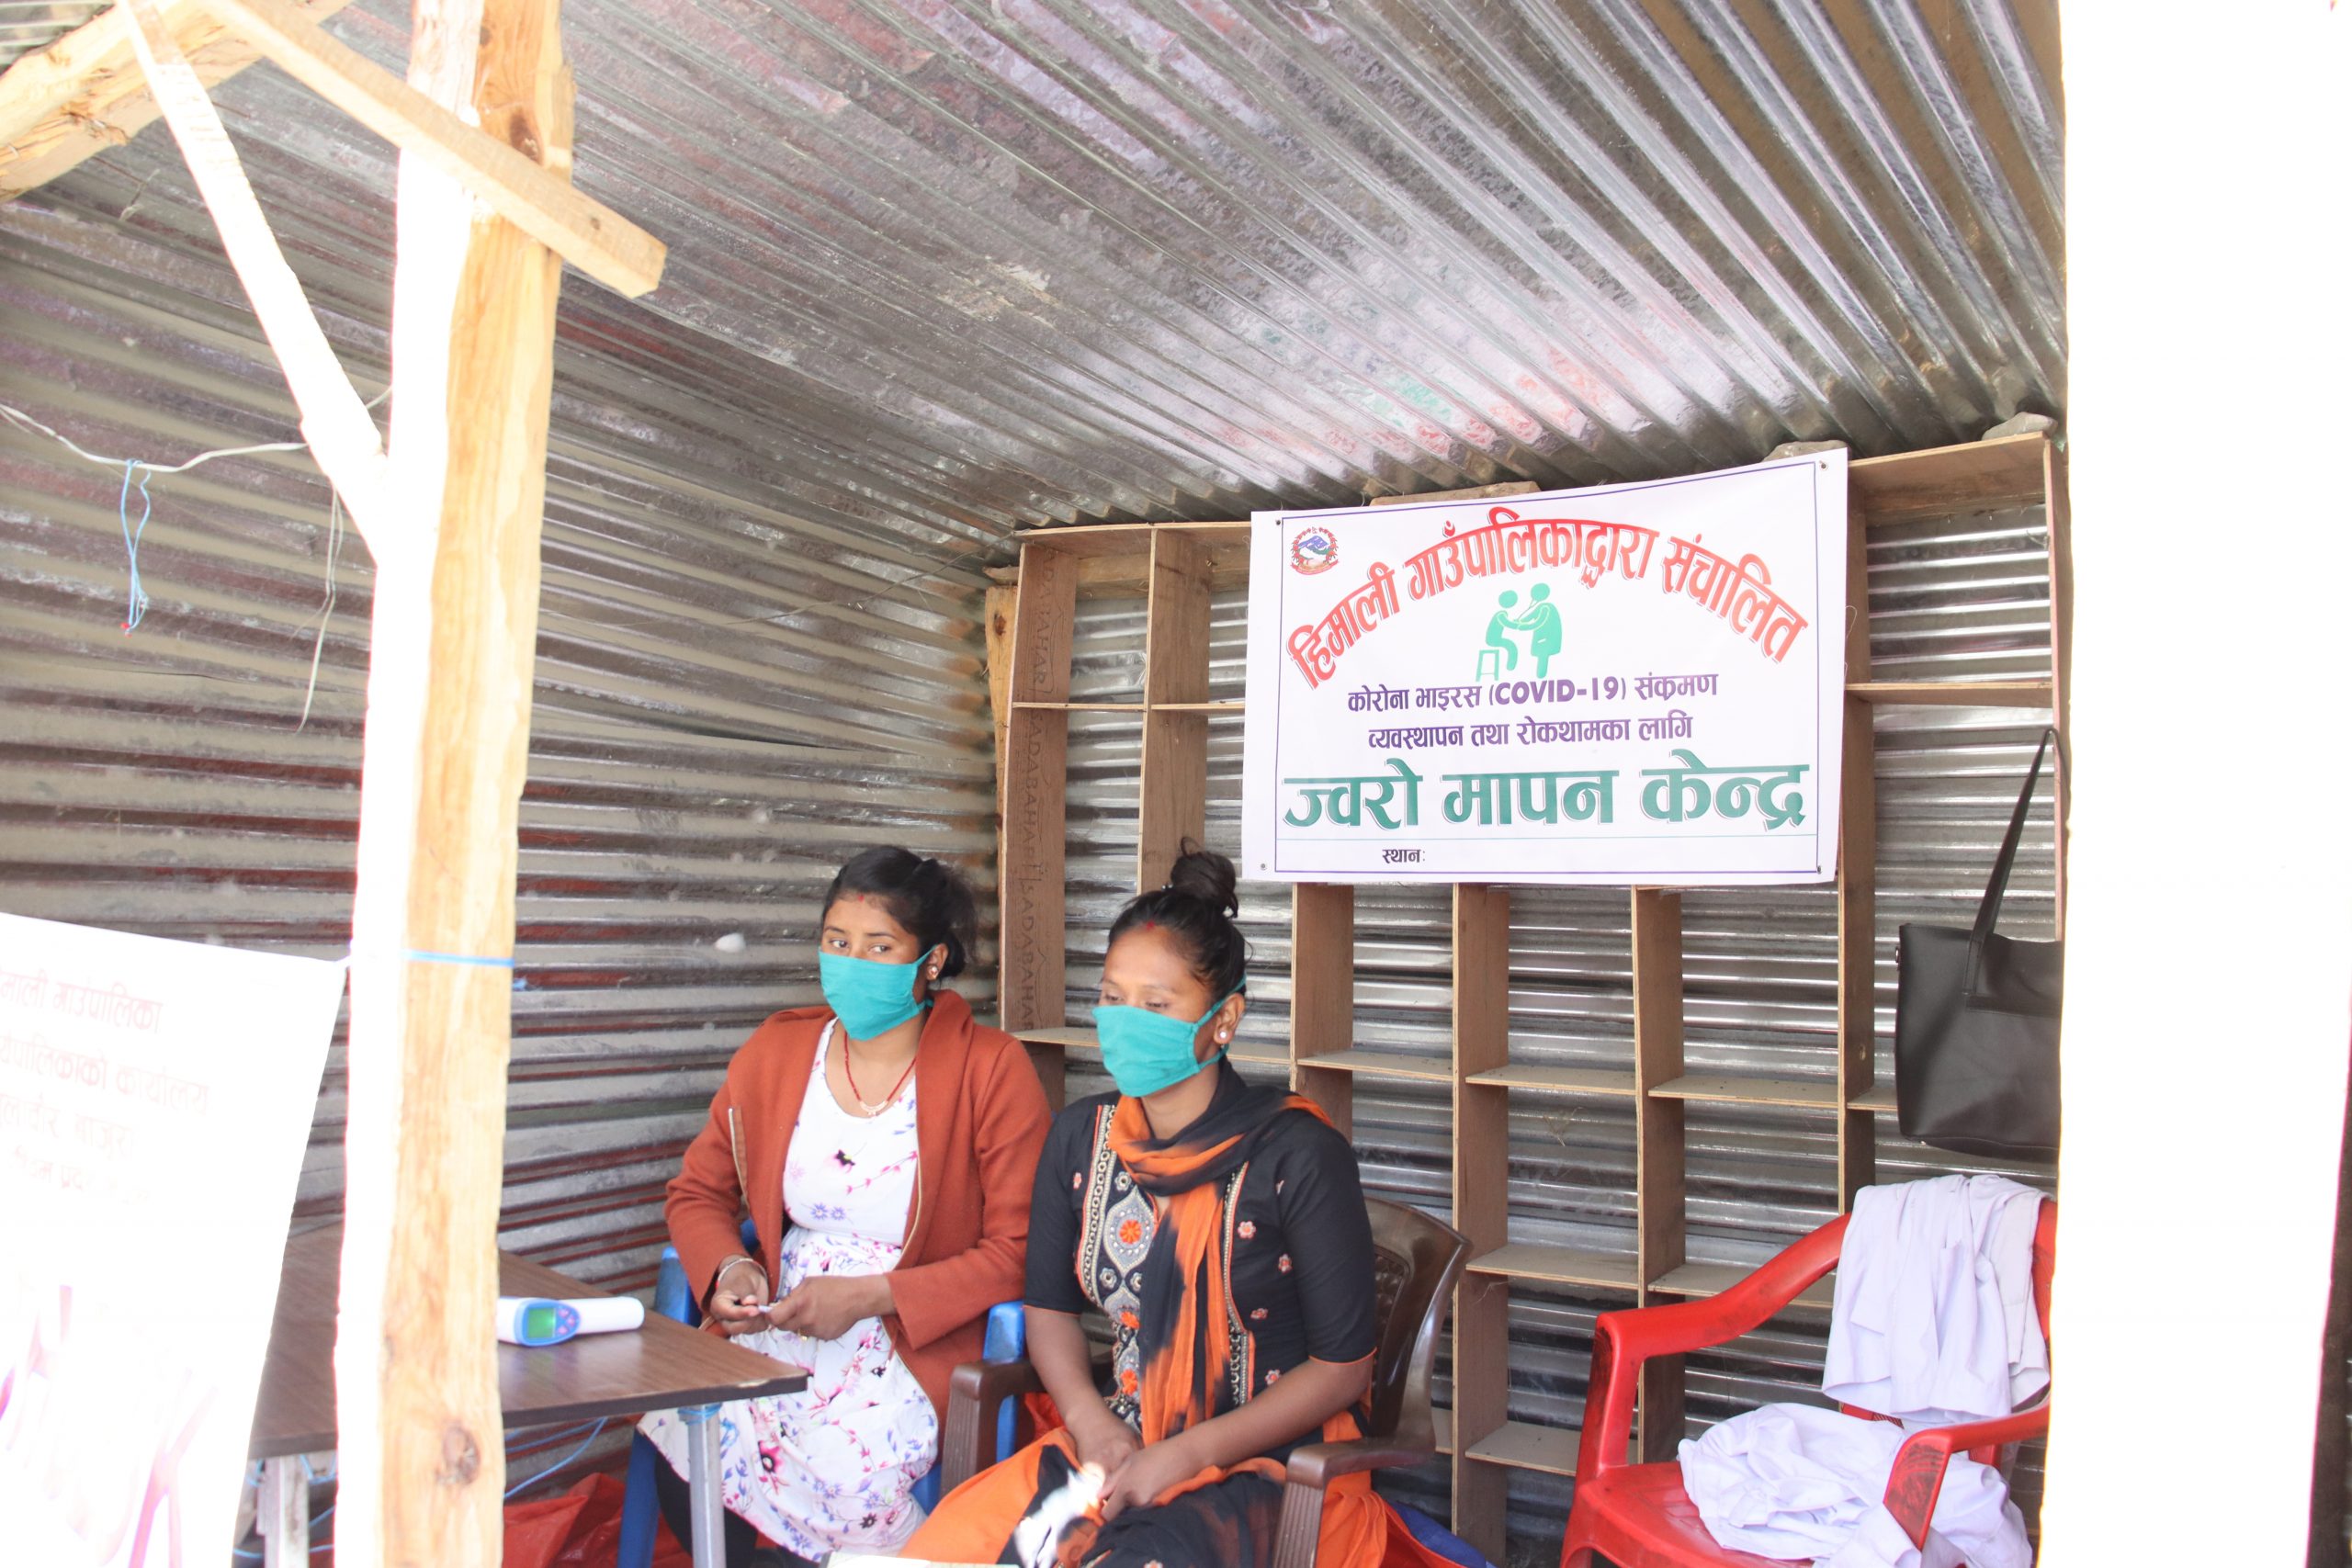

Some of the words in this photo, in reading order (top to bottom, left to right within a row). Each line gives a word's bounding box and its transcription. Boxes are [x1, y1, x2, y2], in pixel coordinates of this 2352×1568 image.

[1287, 561, 1401, 690] हिमाली
[1663, 533, 1808, 664] संचालित
[1348, 683, 1410, 712] कोरोना
[1415, 685, 1483, 711] भाइरस
[1488, 676, 1626, 705] (COVID-19)
[1634, 671, 1719, 701] संक्रमण
[1368, 726, 1464, 750] व्यवस्थापन
[1470, 724, 1510, 747] तथा
[1516, 716, 1631, 745] रोकथामका
[1638, 709, 1693, 741] लागि
[1283, 758, 1424, 830] ज्वरो
[1440, 771, 1620, 826] मापन
[1639, 749, 1810, 830] केन्द्र
[0, 966, 49, 1009] माली
